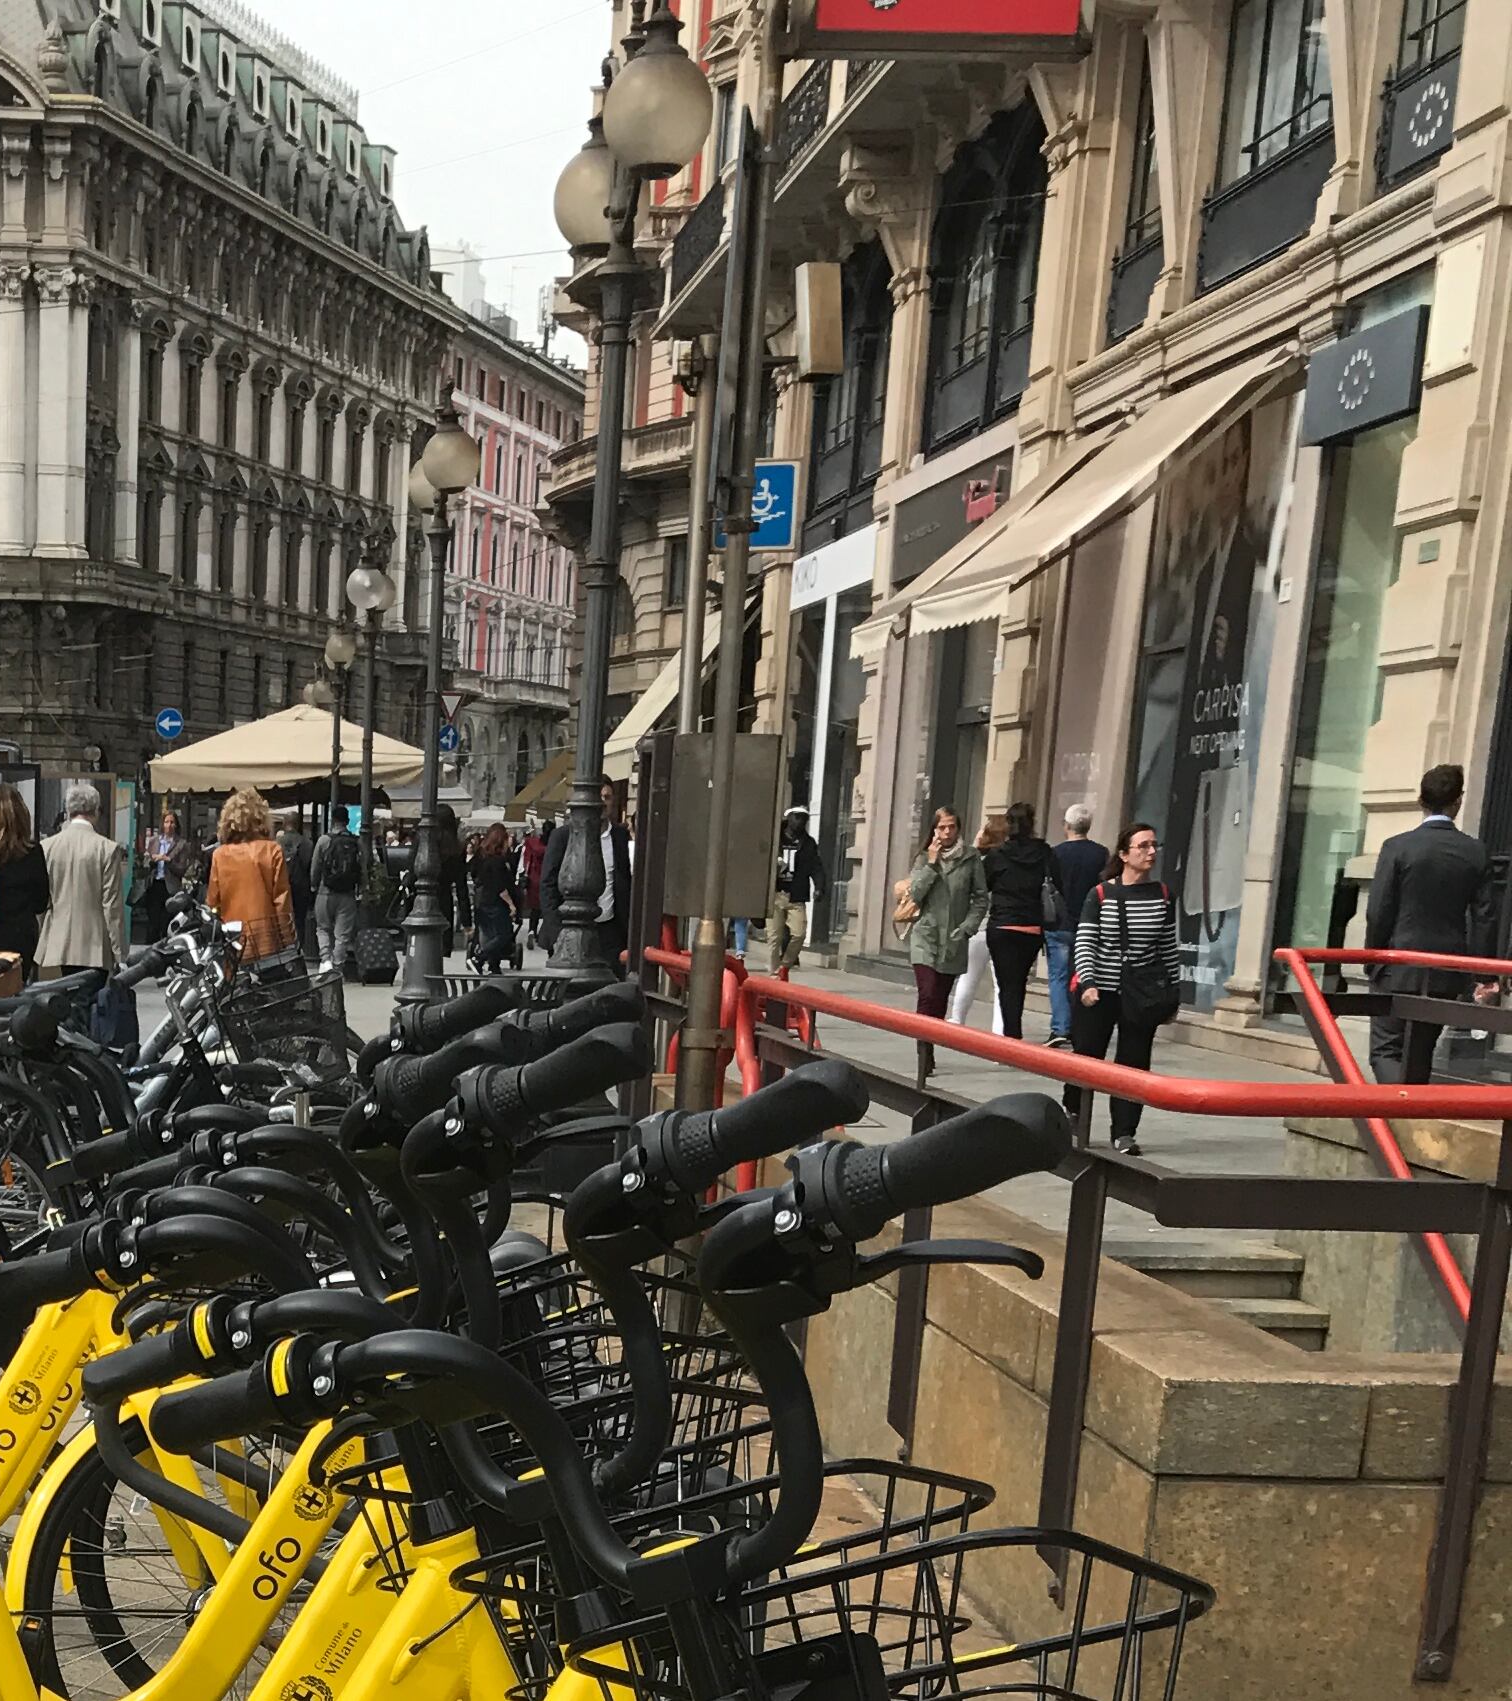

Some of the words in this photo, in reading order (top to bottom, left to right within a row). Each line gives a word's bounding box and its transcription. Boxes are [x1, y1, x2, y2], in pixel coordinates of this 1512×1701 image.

[1193, 682, 1249, 722] CARPISA
[35, 1349, 57, 1379] Milano
[253, 1537, 301, 1600] ofo
[314, 1629, 343, 1671] Comune
[324, 1627, 363, 1677] Milano
